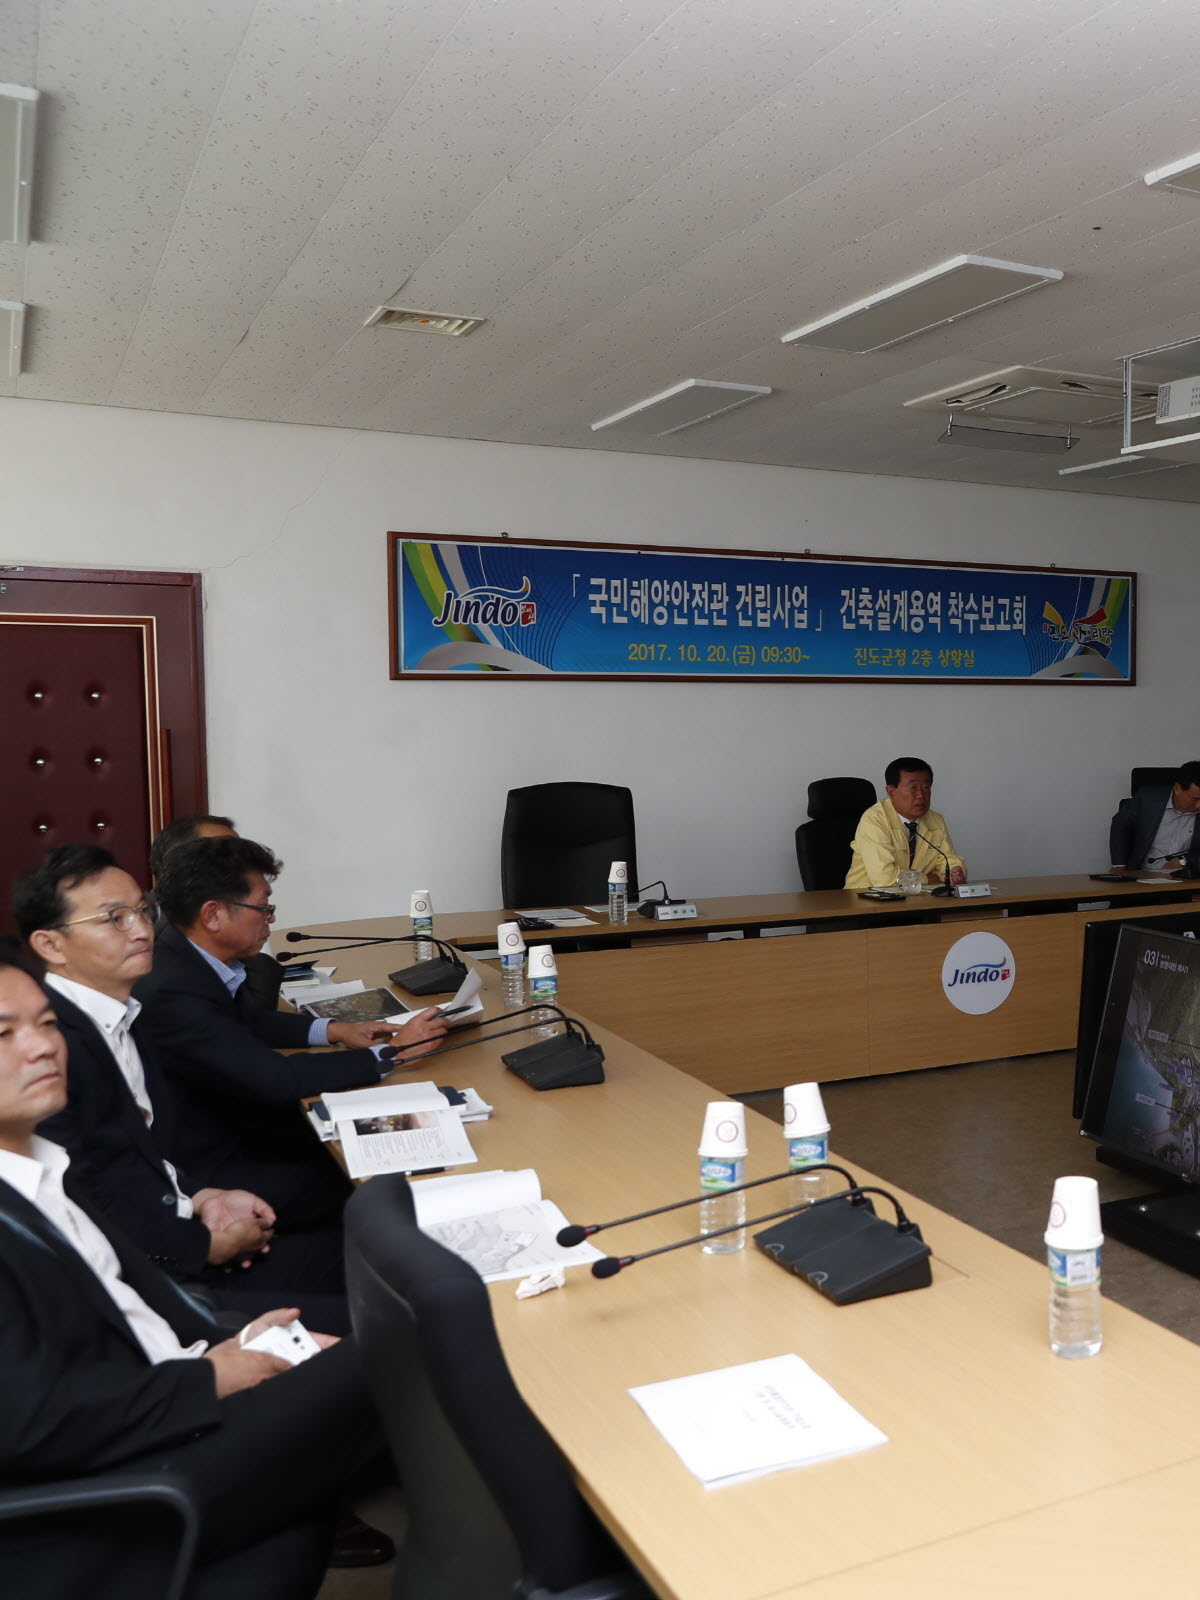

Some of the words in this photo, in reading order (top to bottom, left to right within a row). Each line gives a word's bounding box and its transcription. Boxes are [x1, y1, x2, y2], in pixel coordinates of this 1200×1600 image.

[433, 591, 520, 628] Jindo
[840, 587, 941, 634] 건축설계용역
[947, 591, 1027, 636] 착수보고회
[628, 643, 672, 661] 2017.
[678, 645, 701, 662] 10.
[761, 646, 810, 663] 09:30~
[854, 648, 907, 667] 진도군청
[911, 648, 931, 667] 2층
[937, 648, 975, 668] 상황실
[1144, 949, 1157, 966] 03
[948, 968, 1000, 987] Jindo
